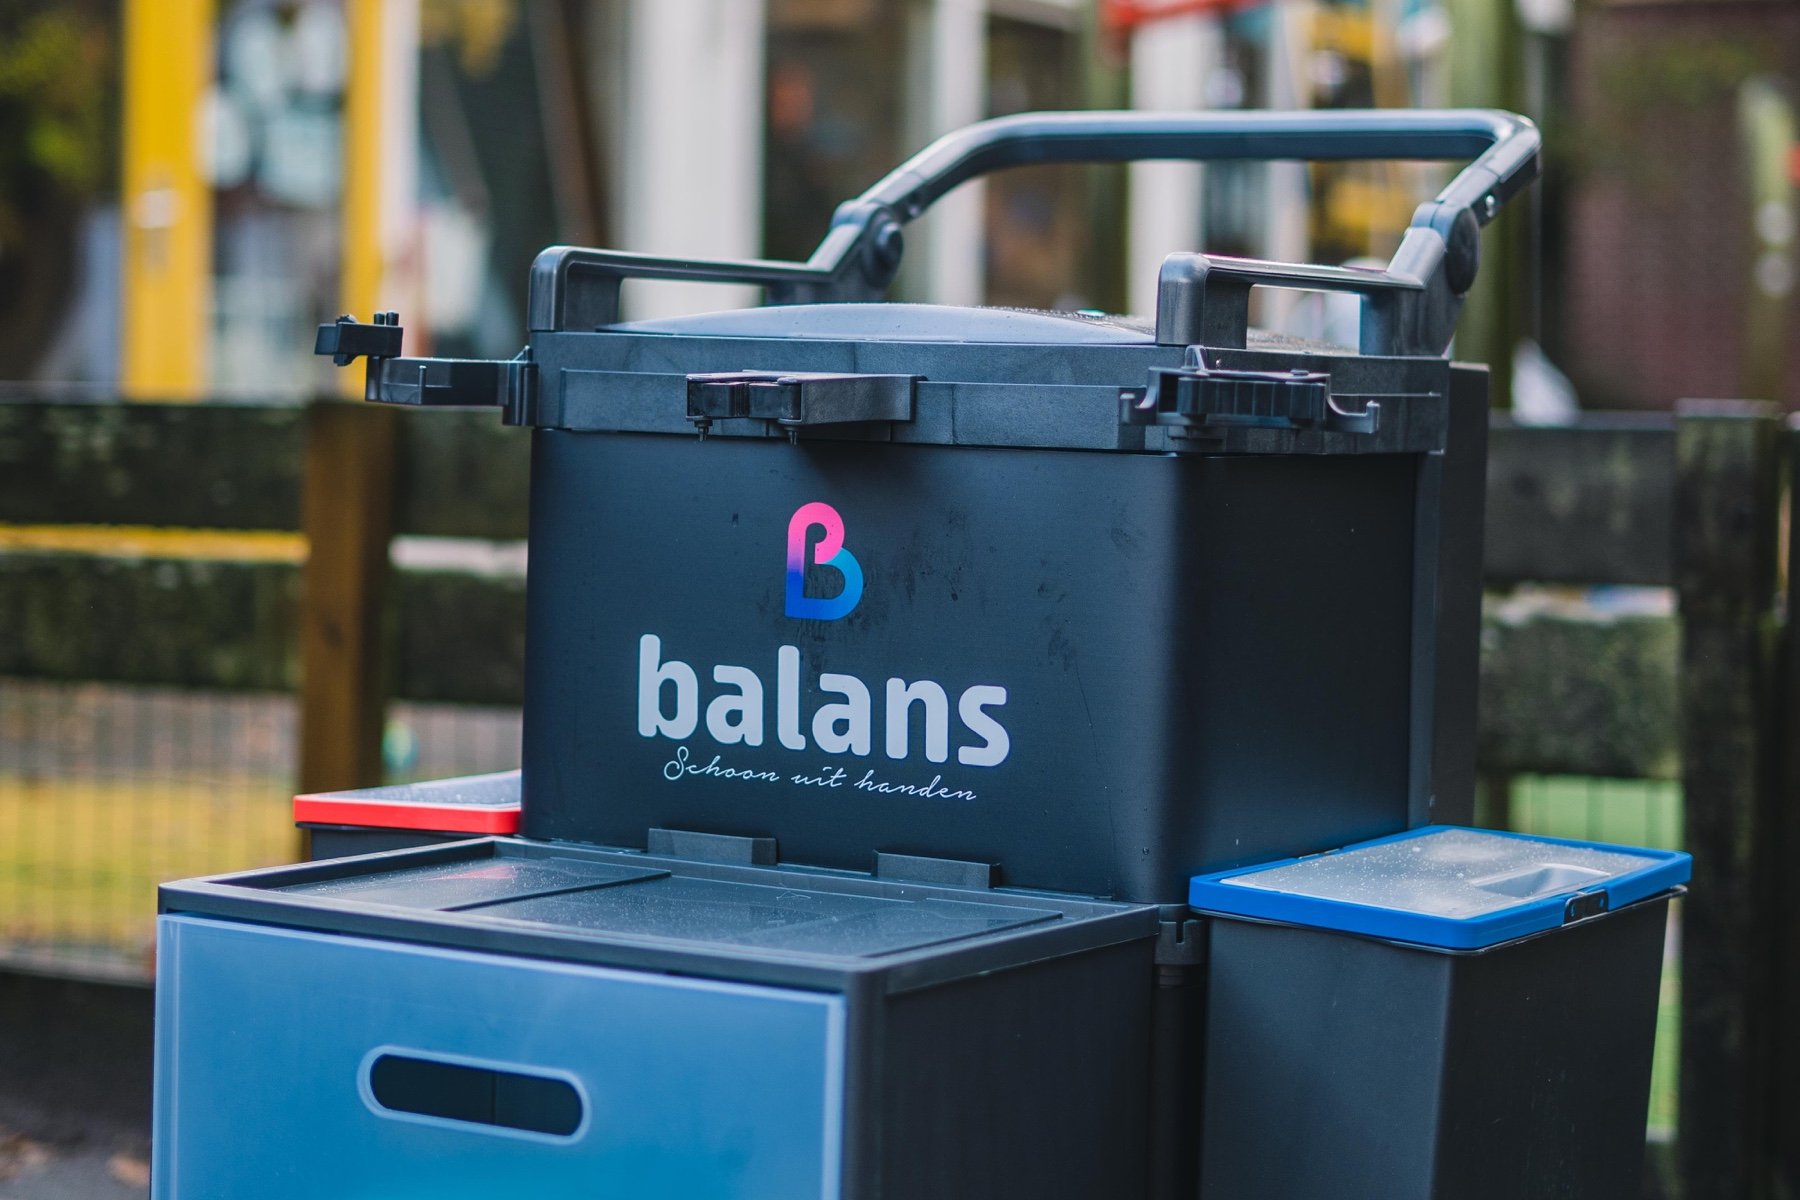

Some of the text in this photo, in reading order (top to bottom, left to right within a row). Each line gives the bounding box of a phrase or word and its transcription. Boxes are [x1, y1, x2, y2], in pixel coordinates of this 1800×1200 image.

[637, 633, 1011, 767] balans
[664, 745, 978, 801] Schoon uit handen
